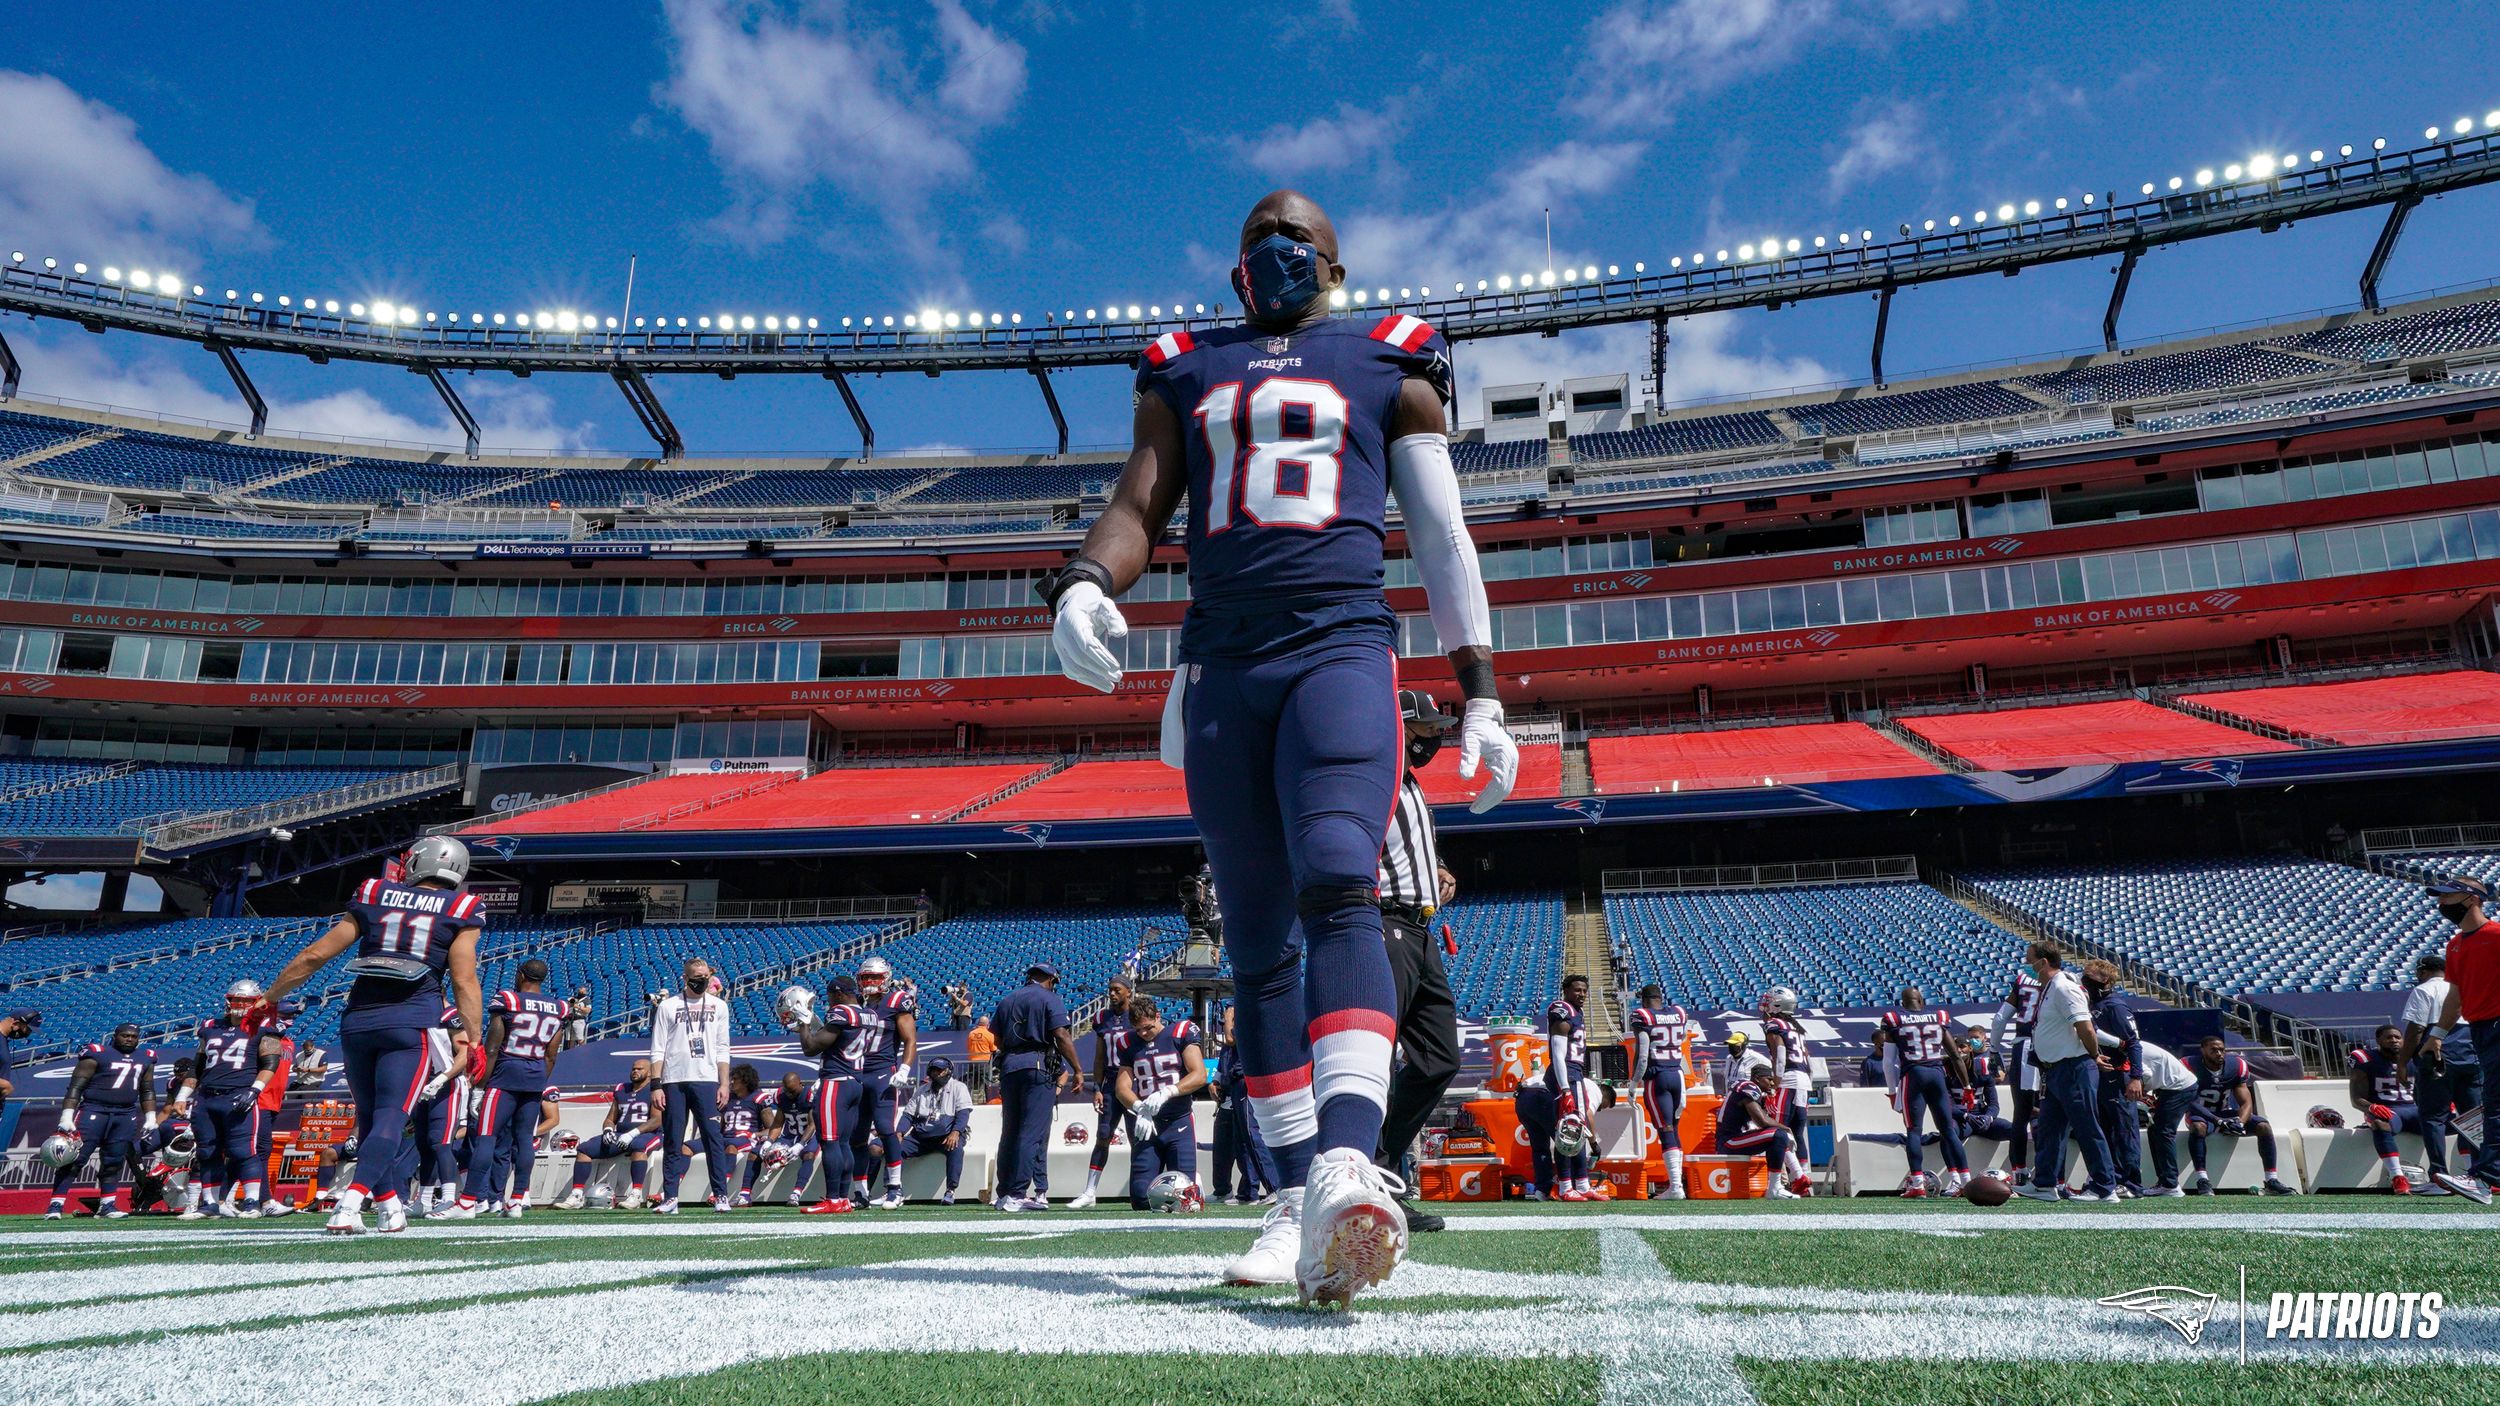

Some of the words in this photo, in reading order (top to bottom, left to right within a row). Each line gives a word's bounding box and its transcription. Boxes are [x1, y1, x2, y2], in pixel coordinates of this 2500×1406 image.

[1247, 357, 1302, 371] PATRIOTS
[1193, 376, 1350, 538] 18
[483, 545, 510, 554] DELL
[510, 546, 565, 556] Technologies
[1833, 557, 1878, 571] BANK
[1883, 554, 1904, 566] OF
[1908, 547, 1985, 563] AMERICA
[1573, 580, 1618, 593] ERICA
[71, 614, 120, 625] BANK
[125, 616, 148, 627] OF
[151, 618, 229, 632] AMERICA
[959, 616, 997, 627] BANK
[1002, 615, 1019, 625] OF
[2034, 612, 2083, 627] BANK
[2087, 610, 2110, 622] OF
[2115, 601, 2200, 619] AMERICA
[724, 623, 766, 633] ERICA
[1658, 647, 1701, 659] BANK
[1705, 644, 1725, 656] OF
[1730, 638, 1804, 654] AMERICA
[791, 690, 830, 700] BANK
[834, 689, 853, 699] OF
[856, 687, 922, 698] AMERICA
[1117, 680, 1157, 690] BANK
[250, 693, 293, 703] BANK
[297, 693, 316, 703] OF
[320, 693, 391, 704] AMERICA
[1514, 733, 1560, 743] Putnam
[724, 760, 769, 770] Putnam
[380, 889, 446, 913] EDELMAN
[380, 910, 435, 960] 11
[525, 998, 559, 1015] BETHEL
[1655, 1014, 1681, 1025] BROOKS
[1901, 1013, 1938, 1024] McCOURTY
[503, 1013, 561, 1057] 29
[1650, 1026, 1684, 1060] 25
[1899, 1024, 1943, 1062] 32
[204, 1038, 249, 1069] 64
[1500, 1042, 1518, 1062] G
[110, 1062, 143, 1090] 71
[1133, 1053, 1180, 1097] 85
[618, 1102, 648, 1123] 72
[724, 1110, 752, 1131] 96
[1460, 1171, 1481, 1196] G
[1708, 1168, 1731, 1193] G
